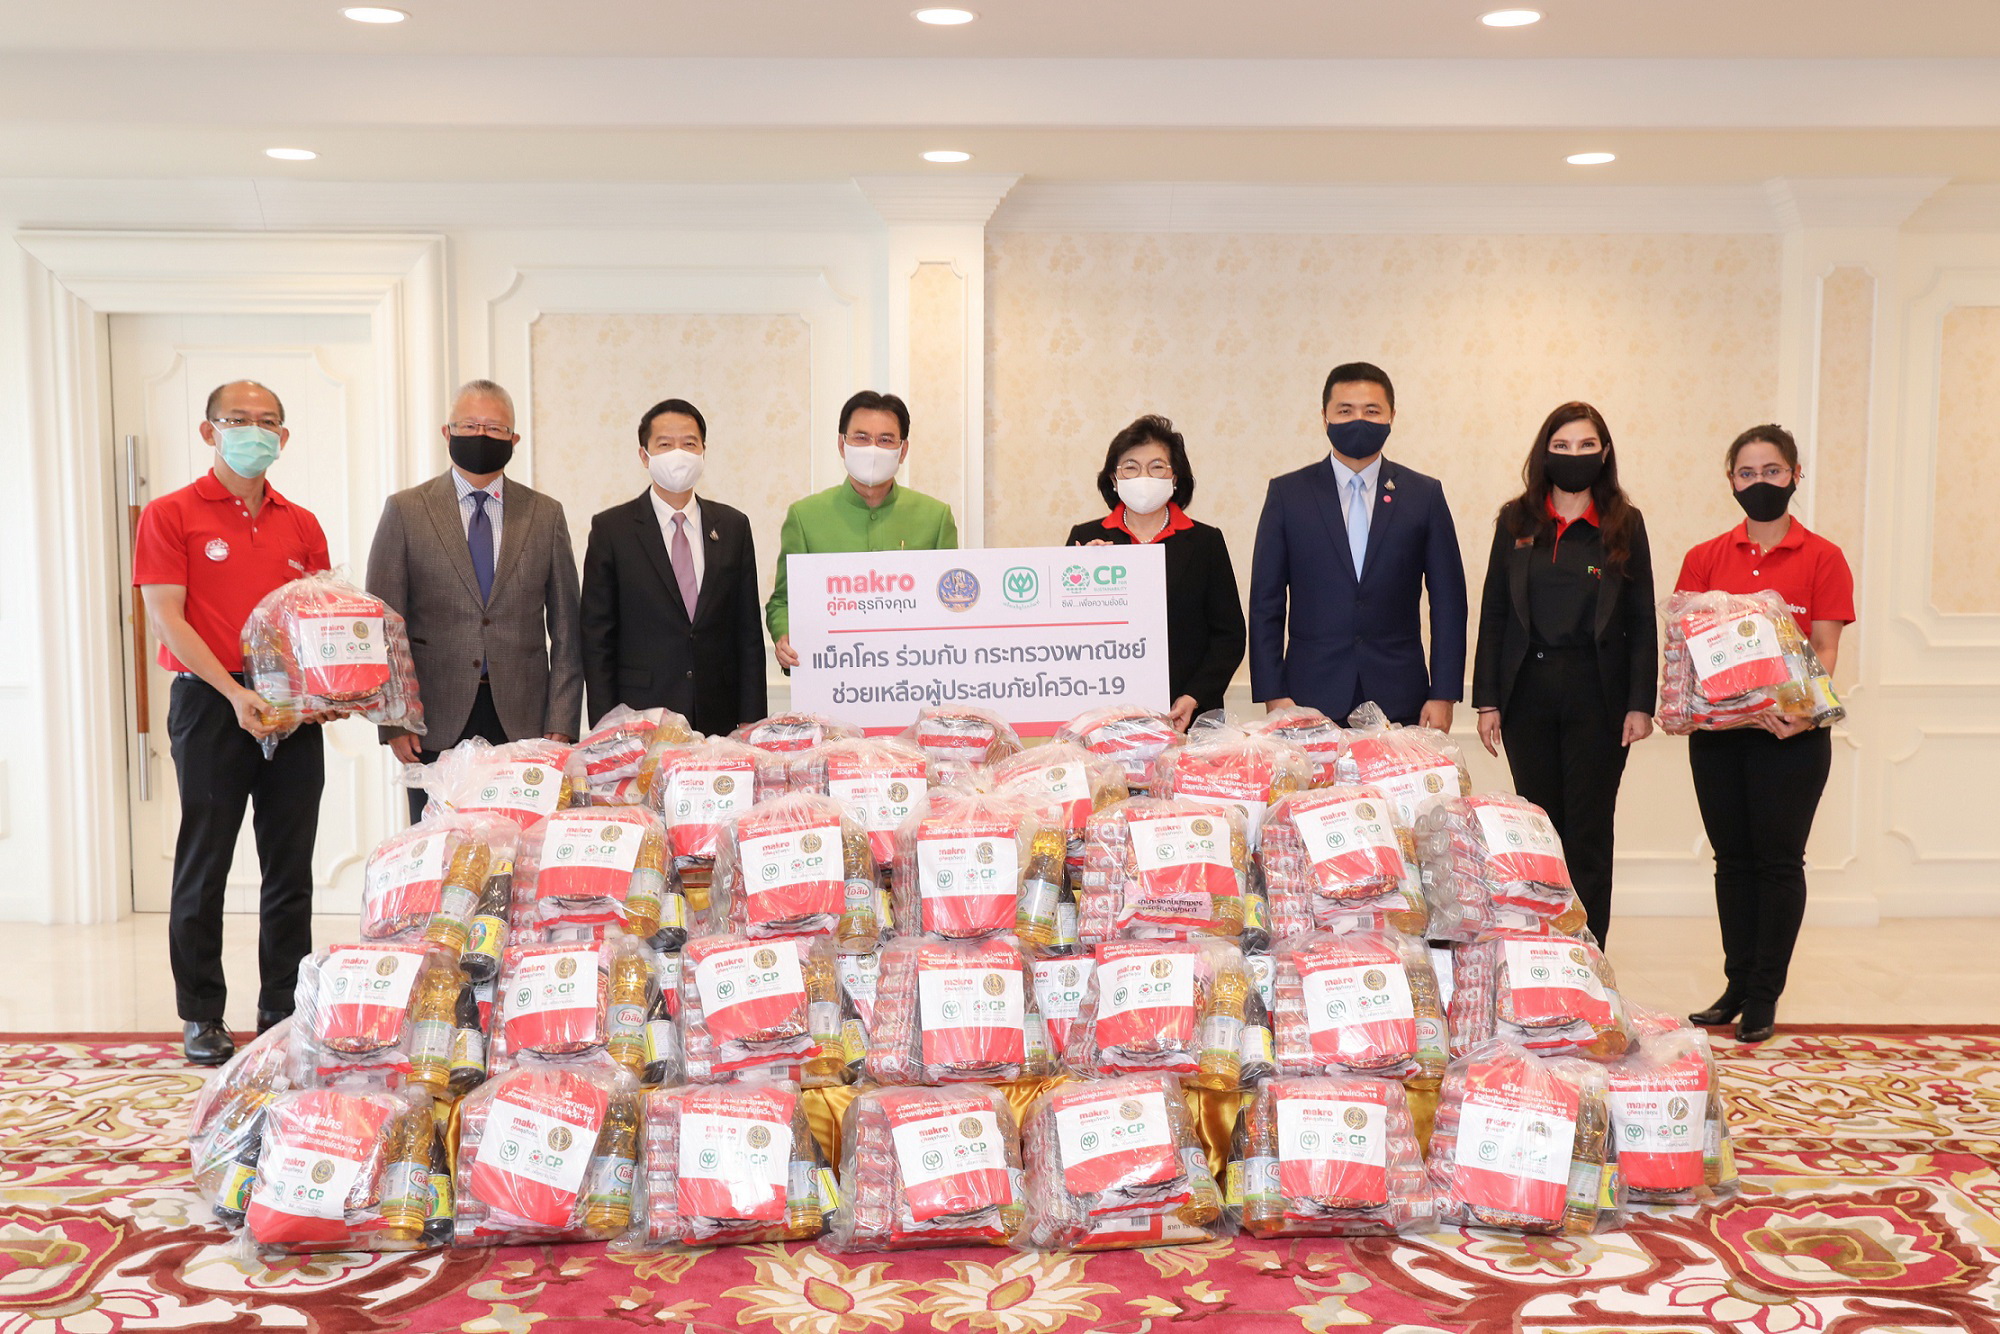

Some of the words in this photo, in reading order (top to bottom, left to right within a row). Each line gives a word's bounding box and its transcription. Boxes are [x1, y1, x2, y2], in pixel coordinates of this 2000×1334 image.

[1093, 565, 1127, 585] CP
[827, 569, 916, 593] makro
[827, 597, 917, 616] คู่คิดธุรกิจคุณ
[359, 642, 371, 651] CP
[812, 643, 889, 669] แม็คโคร
[896, 643, 967, 667] ร่วมกับ
[974, 637, 1147, 664] กระทรวงพาณิชย์
[832, 673, 1126, 706] ช่วยเหลือผู้ประสบภัยโควิด-19
[523, 788, 540, 798] CP
[717, 800, 733, 809] CP
[893, 807, 908, 816] CP
[600, 846, 617, 855] CP
[762, 841, 790, 851] makro
[806, 857, 823, 866] CP
[980, 869, 996, 878] CP
[714, 957, 744, 969] makro
[520, 964, 545, 974] makro
[1577, 968, 1590, 979] CP
[762, 972, 779, 982] CP
[1324, 977, 1353, 987] makro
[373, 980, 391, 989] CP
[558, 983, 575, 993] CP
[1154, 983, 1171, 992] CP
[1063, 991, 1080, 1001] CP
[1372, 994, 1390, 1005] CP
[989, 1001, 1006, 1011] CP
[1079, 1108, 1109, 1119] makro
[1303, 1108, 1333, 1116] makro
[918, 1125, 948, 1136] makro
[1128, 1123, 1145, 1134] CP
[1673, 1125, 1688, 1135] CP
[1350, 1135, 1366, 1145] CP
[970, 1143, 987, 1152] CP
[284, 1157, 306, 1167] makro
[545, 1155, 563, 1168] CP
[308, 1188, 324, 1200] CP
